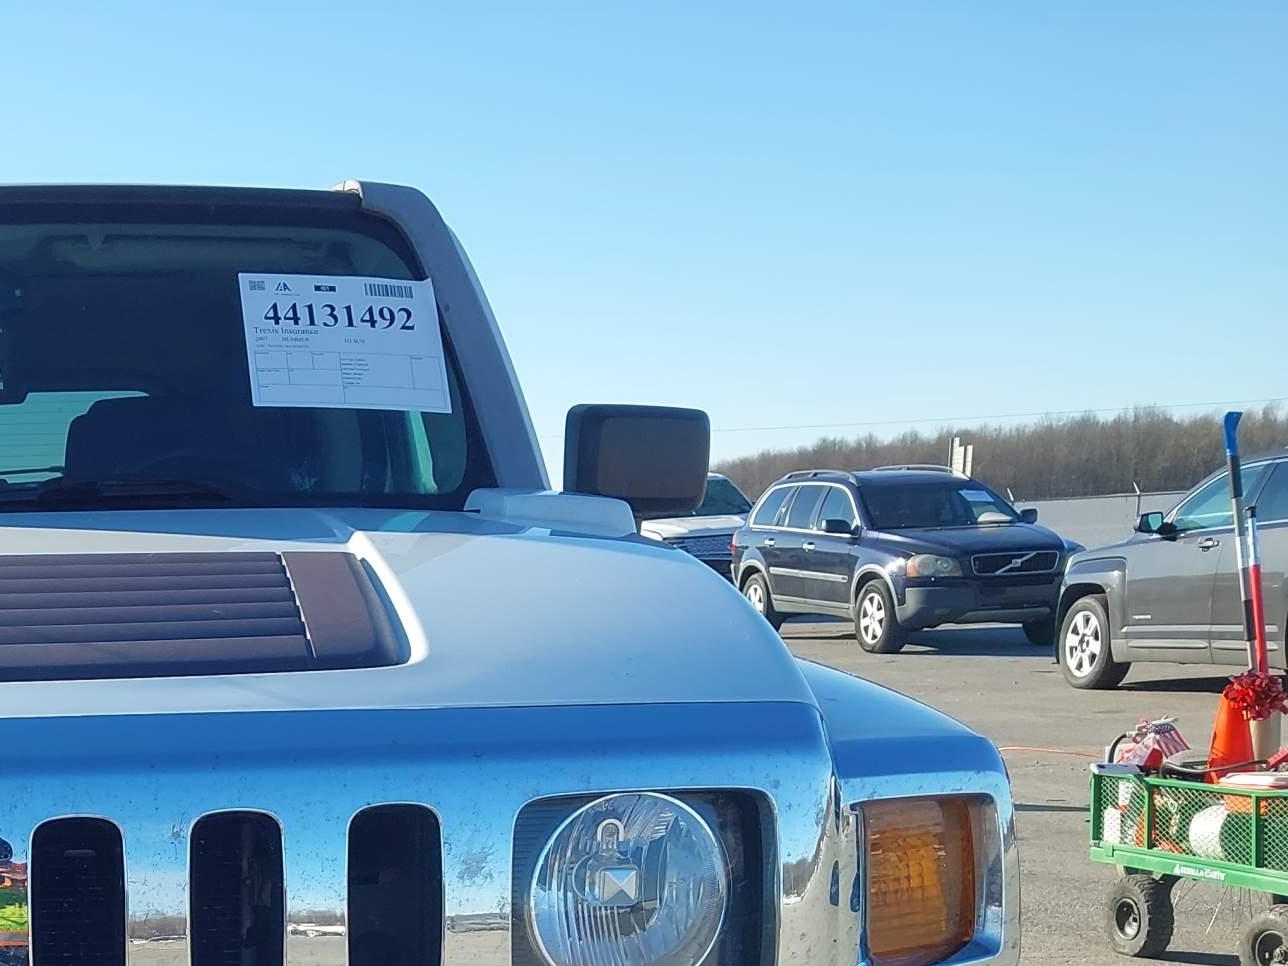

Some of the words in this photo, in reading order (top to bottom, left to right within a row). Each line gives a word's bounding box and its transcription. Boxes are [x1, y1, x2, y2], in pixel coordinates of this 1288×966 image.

[264, 302, 416, 330] 44131492
[281, 327, 319, 335] Insurance
[1180, 866, 1204, 877] GORILLA
